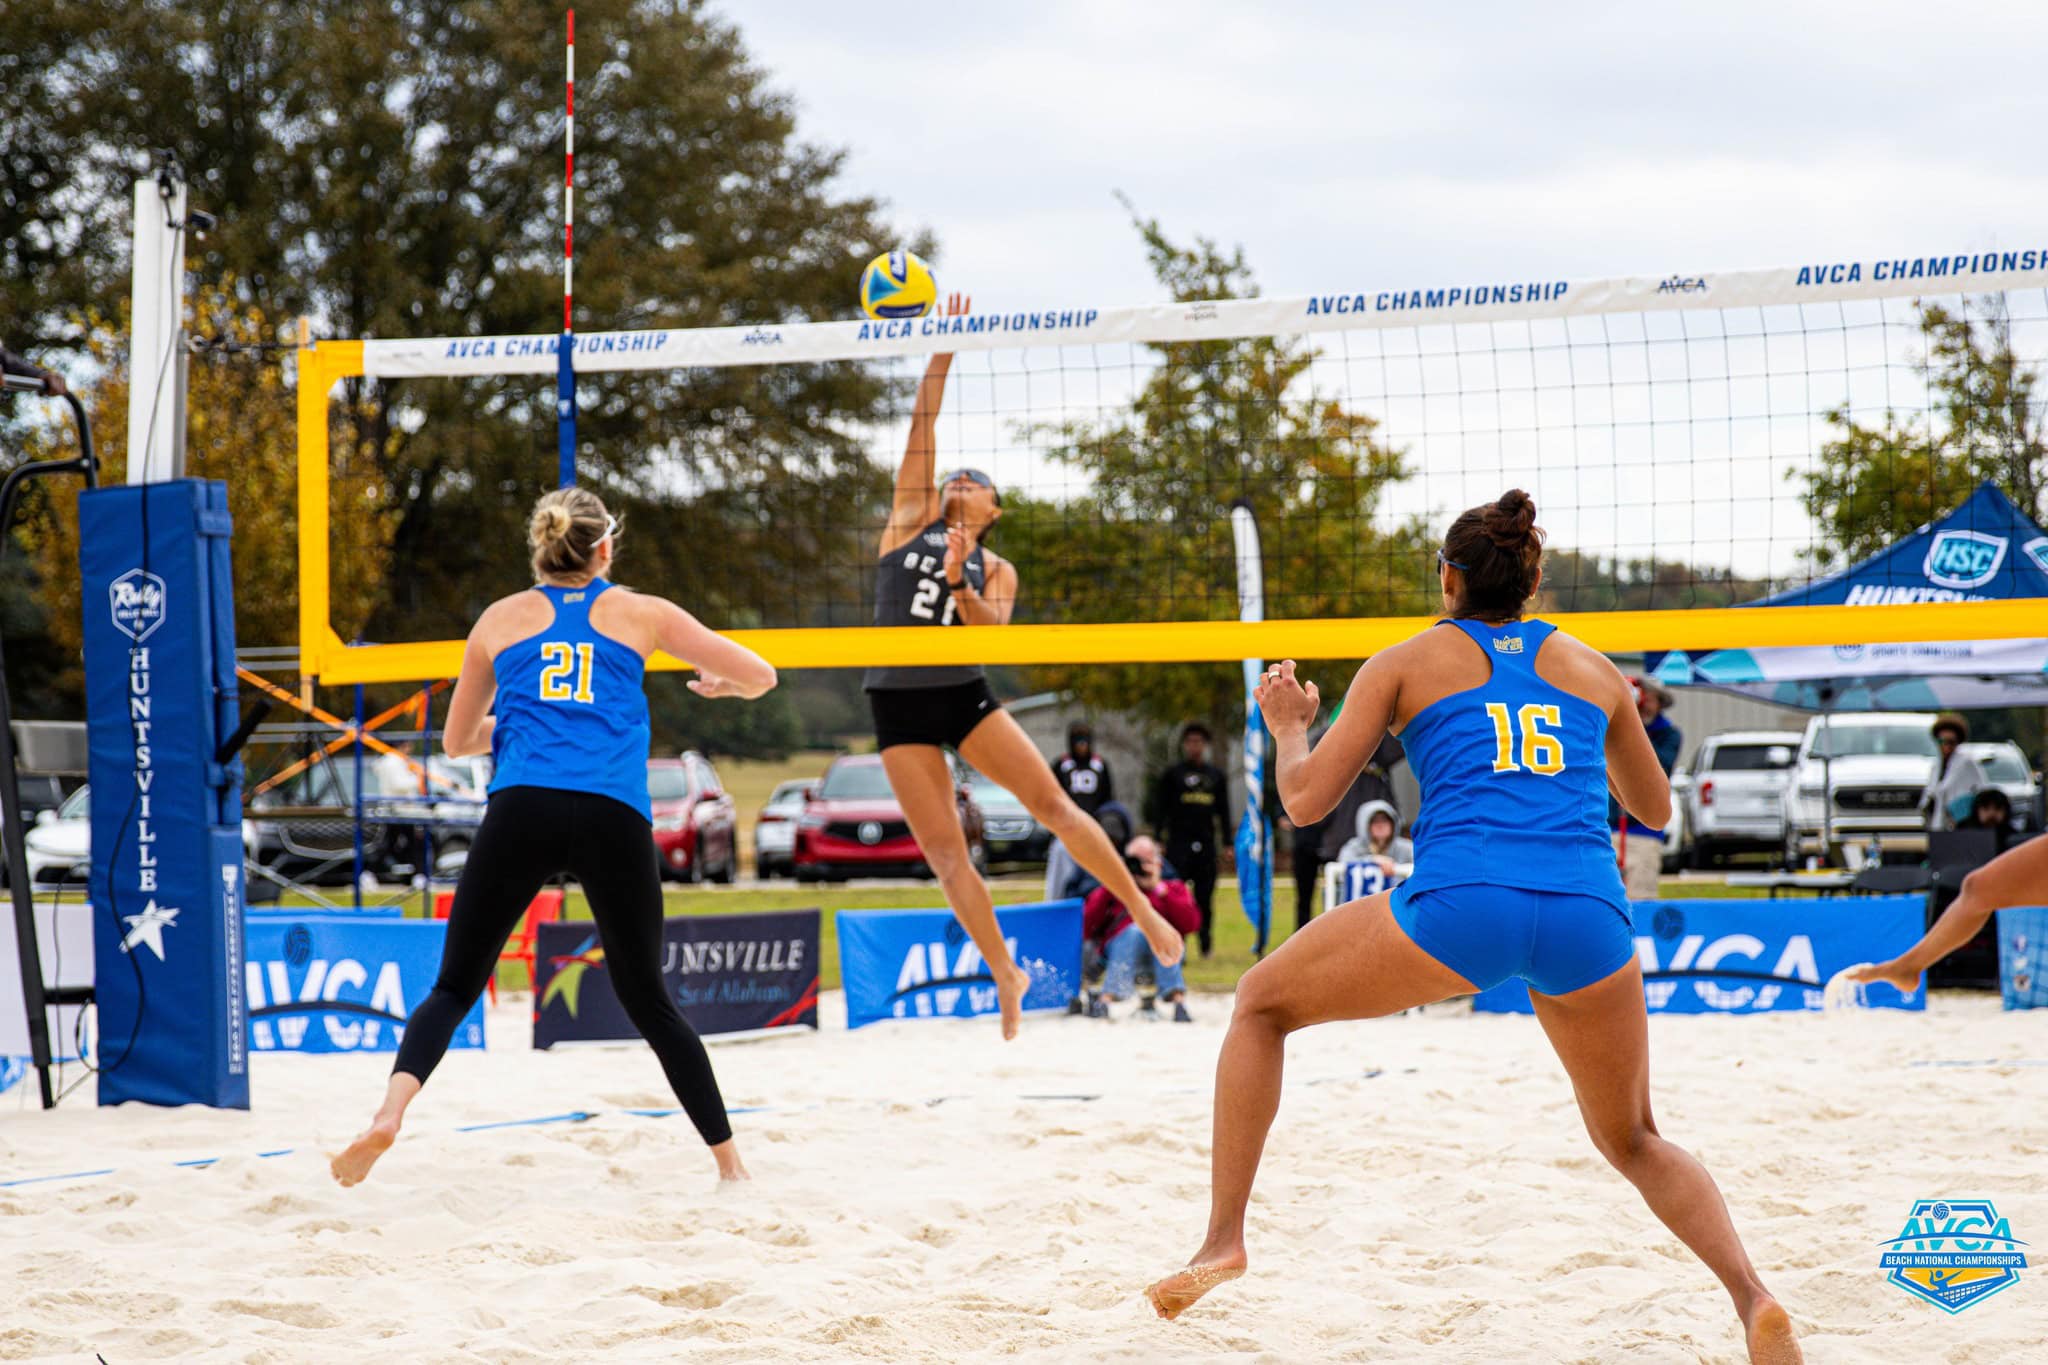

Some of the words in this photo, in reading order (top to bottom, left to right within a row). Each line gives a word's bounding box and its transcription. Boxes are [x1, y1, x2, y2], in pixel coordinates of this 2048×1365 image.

[1795, 262, 1862, 286] AVCA
[1872, 249, 2048, 281] CHAMPIONSH
[1306, 294, 1367, 315] AVCA
[1375, 280, 1569, 312] CHAMPIONSHIP
[858, 322, 912, 342] AVCA
[920, 308, 1099, 337] CHAMPIONSHIP
[445, 339, 497, 359] AVCA
[1933, 542, 1993, 573] HSC
[539, 641, 595, 704] 21
[1484, 702, 1566, 777] 16
[128, 647, 158, 892] HUNTSVILLE
[1634, 933, 1826, 1009] VCA
